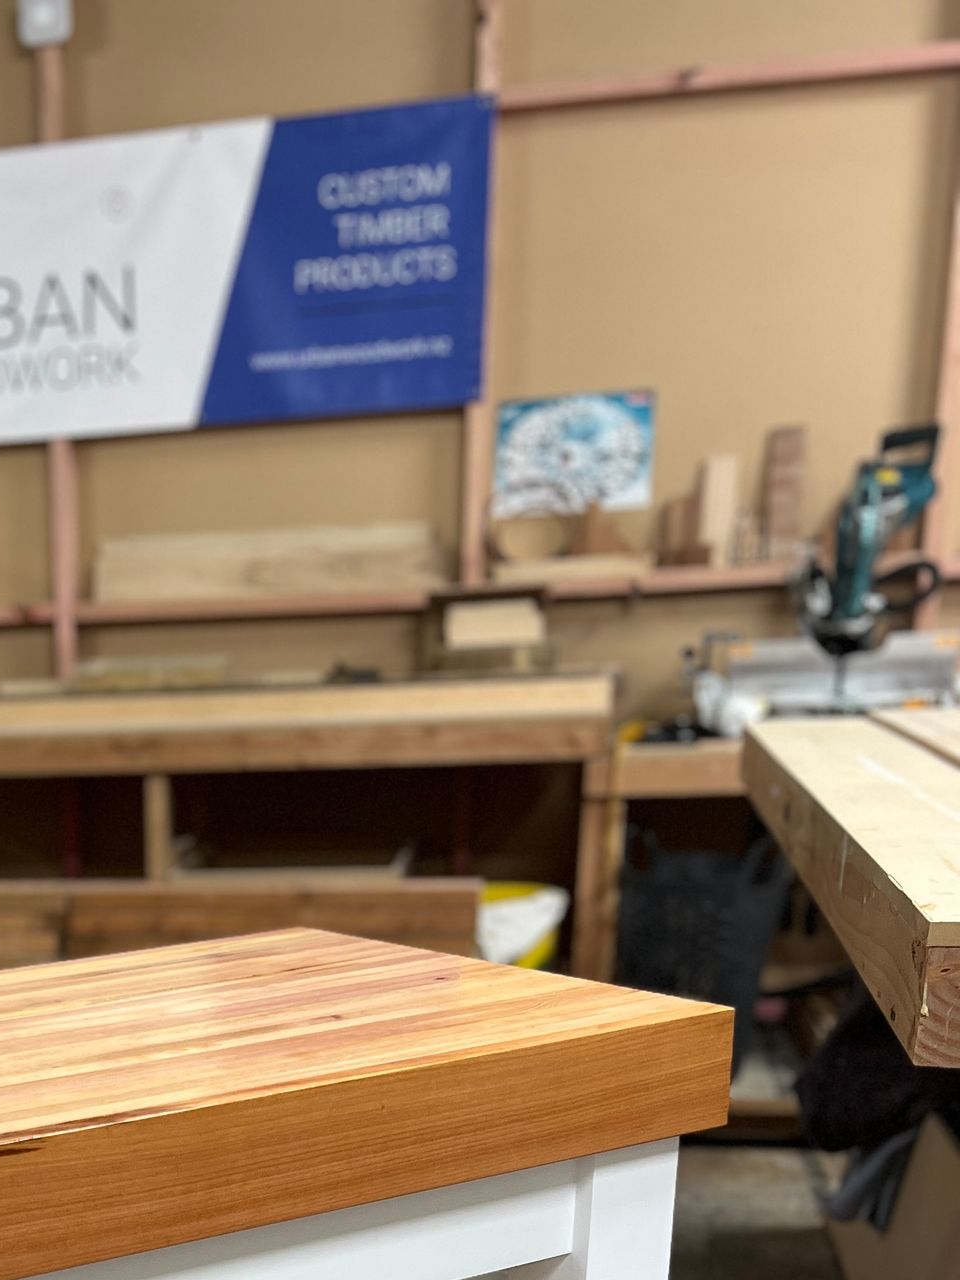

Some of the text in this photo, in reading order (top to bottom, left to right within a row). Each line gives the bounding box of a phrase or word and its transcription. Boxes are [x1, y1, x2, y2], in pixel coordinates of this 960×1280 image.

[318, 162, 451, 210] CUSTOM
[334, 204, 451, 248] TIMBER
[294, 245, 457, 293] PRODUCTS
